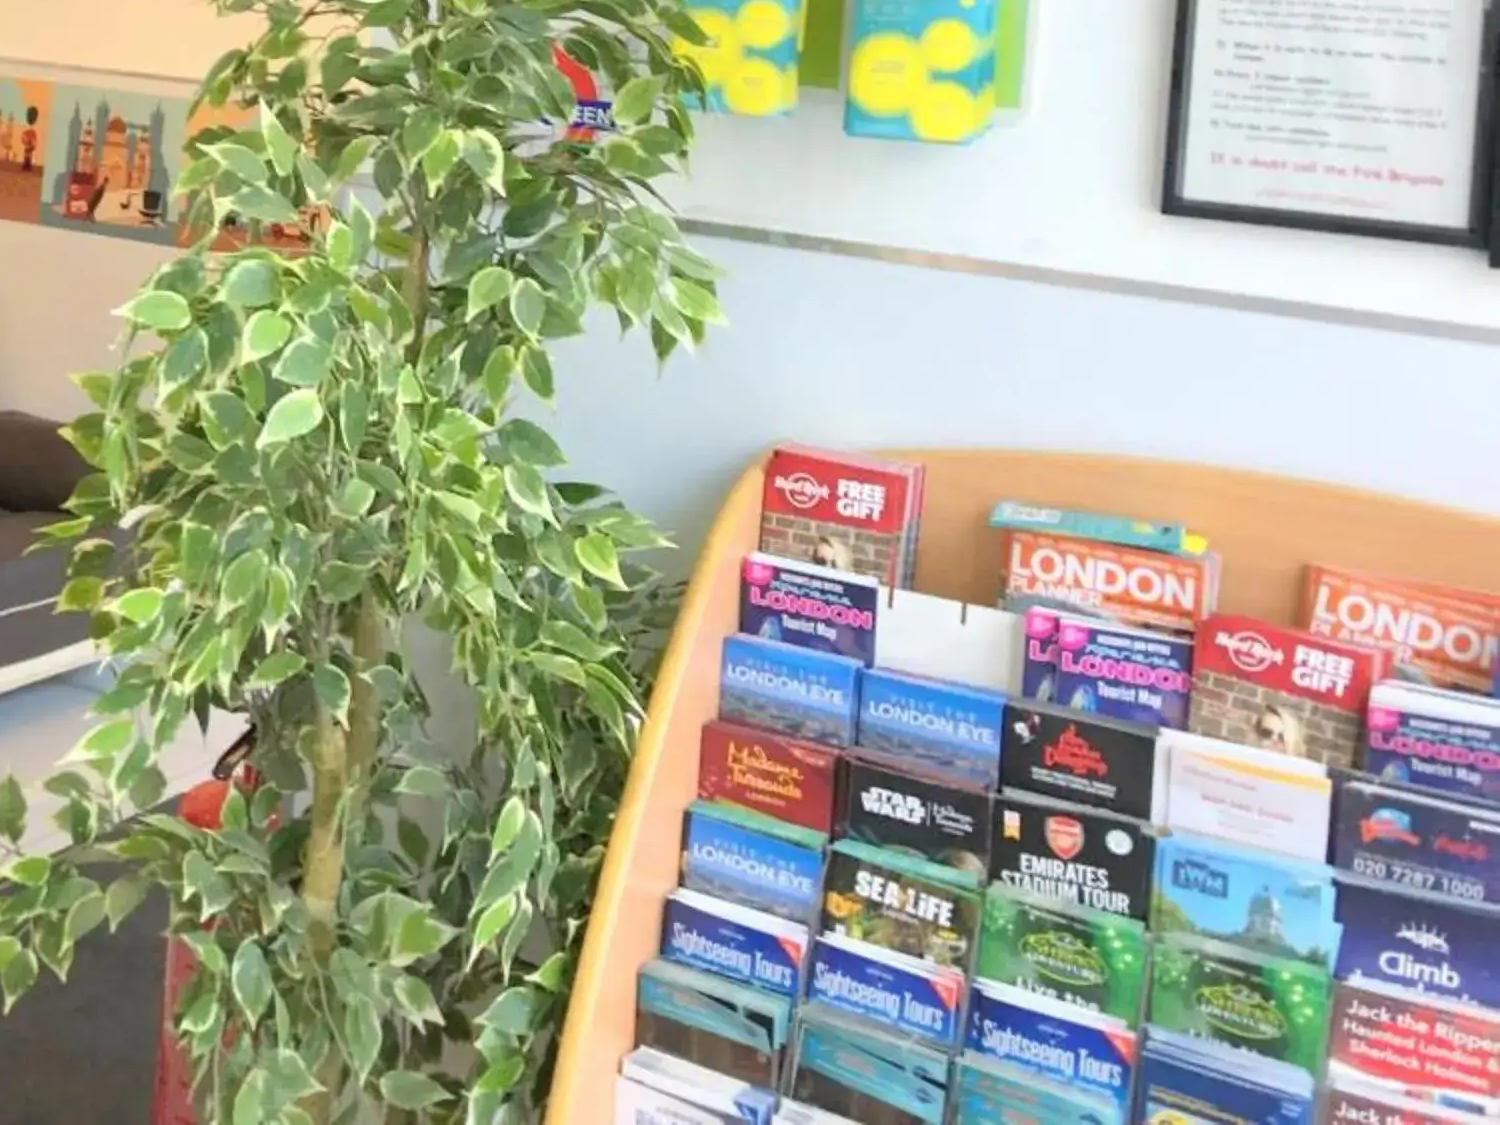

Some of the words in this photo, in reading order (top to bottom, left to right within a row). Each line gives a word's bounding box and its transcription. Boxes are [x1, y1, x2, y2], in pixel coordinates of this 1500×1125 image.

[837, 478, 887, 504] FREE
[837, 498, 884, 521] GIFT
[1009, 576, 1104, 607] PLANNER
[1010, 540, 1197, 611] LONDON
[749, 586, 874, 631] LONDON
[1294, 643, 1355, 675] FREE
[727, 662, 808, 697] LONDON
[809, 683, 844, 706] EYE
[1291, 666, 1350, 698] GIFT
[869, 700, 953, 732] LONDON
[954, 721, 995, 746] EYE
[861, 791, 927, 825] WARS
[868, 786, 922, 810] STAR
[693, 841, 775, 881] LONDON
[776, 869, 815, 894] EYE
[1019, 852, 1110, 889] EMIRATES
[1353, 857, 1387, 877] 020
[1442, 876, 1485, 901] 1000
[854, 869, 901, 909] SEA
[1000, 869, 1079, 906] STADIUM
[1081, 885, 1131, 914] TOUR
[672, 922, 751, 977] Sightseeing
[754, 949, 794, 989] Tours
[1378, 949, 1462, 990] Climb
[813, 961, 901, 1021] Sightseeing
[903, 989, 944, 1032] Tours
[1343, 1018, 1416, 1047] Haunted
[1346, 998, 1392, 1024] Jack
[1396, 1012, 1430, 1034] the
[981, 1019, 1076, 1076] Sightseeing
[1077, 1048, 1123, 1088] Tours
[1349, 1038, 1422, 1071] Sherlock
[1334, 1100, 1381, 1125] Jack
